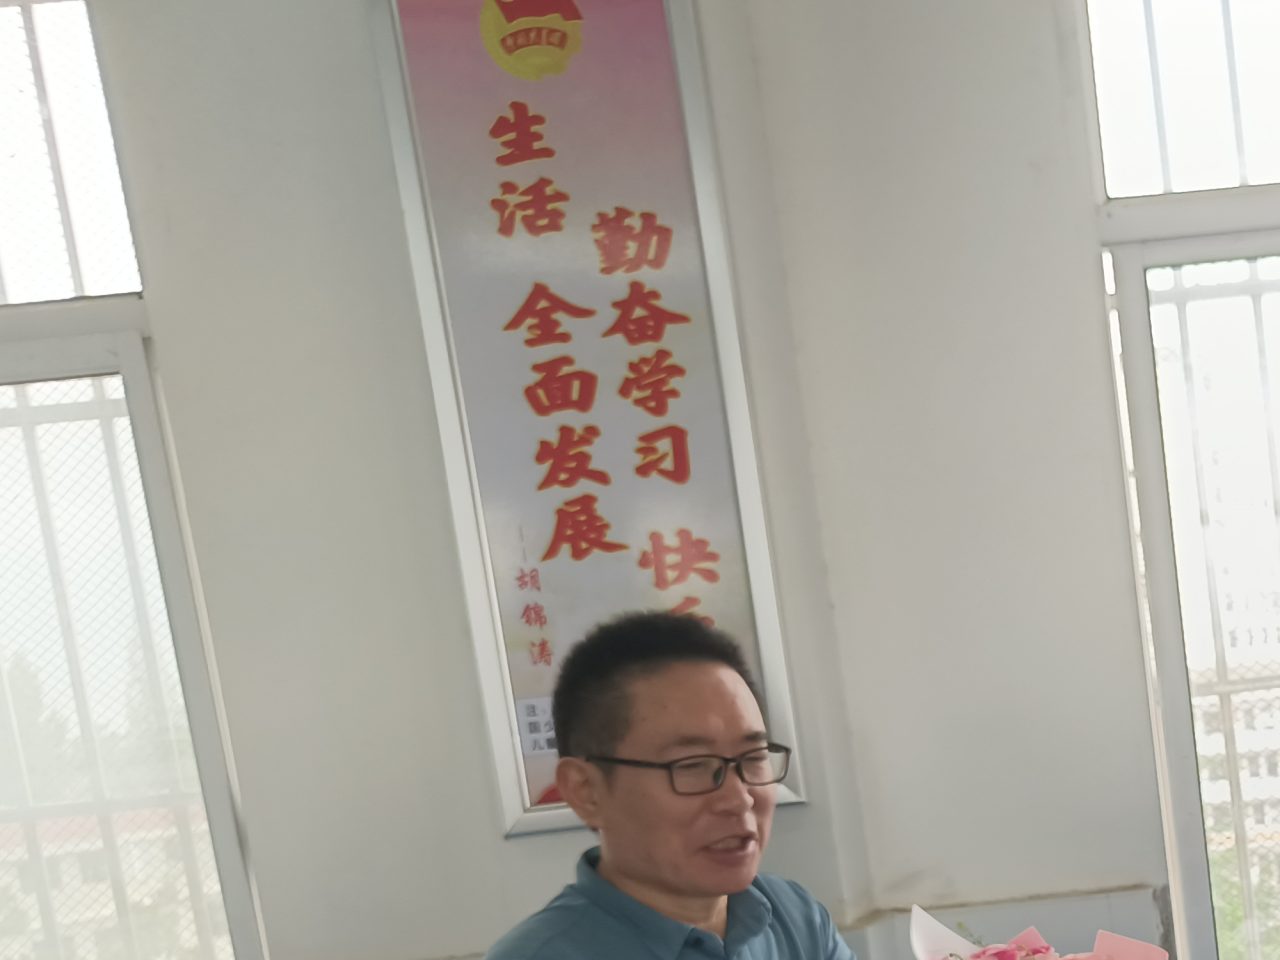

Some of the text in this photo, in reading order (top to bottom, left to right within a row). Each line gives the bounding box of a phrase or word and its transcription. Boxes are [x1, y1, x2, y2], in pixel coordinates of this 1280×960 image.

[489, 101, 570, 238] 生活
[503, 282, 630, 562] 全面发展
[591, 206, 692, 484] 勤奋学习
